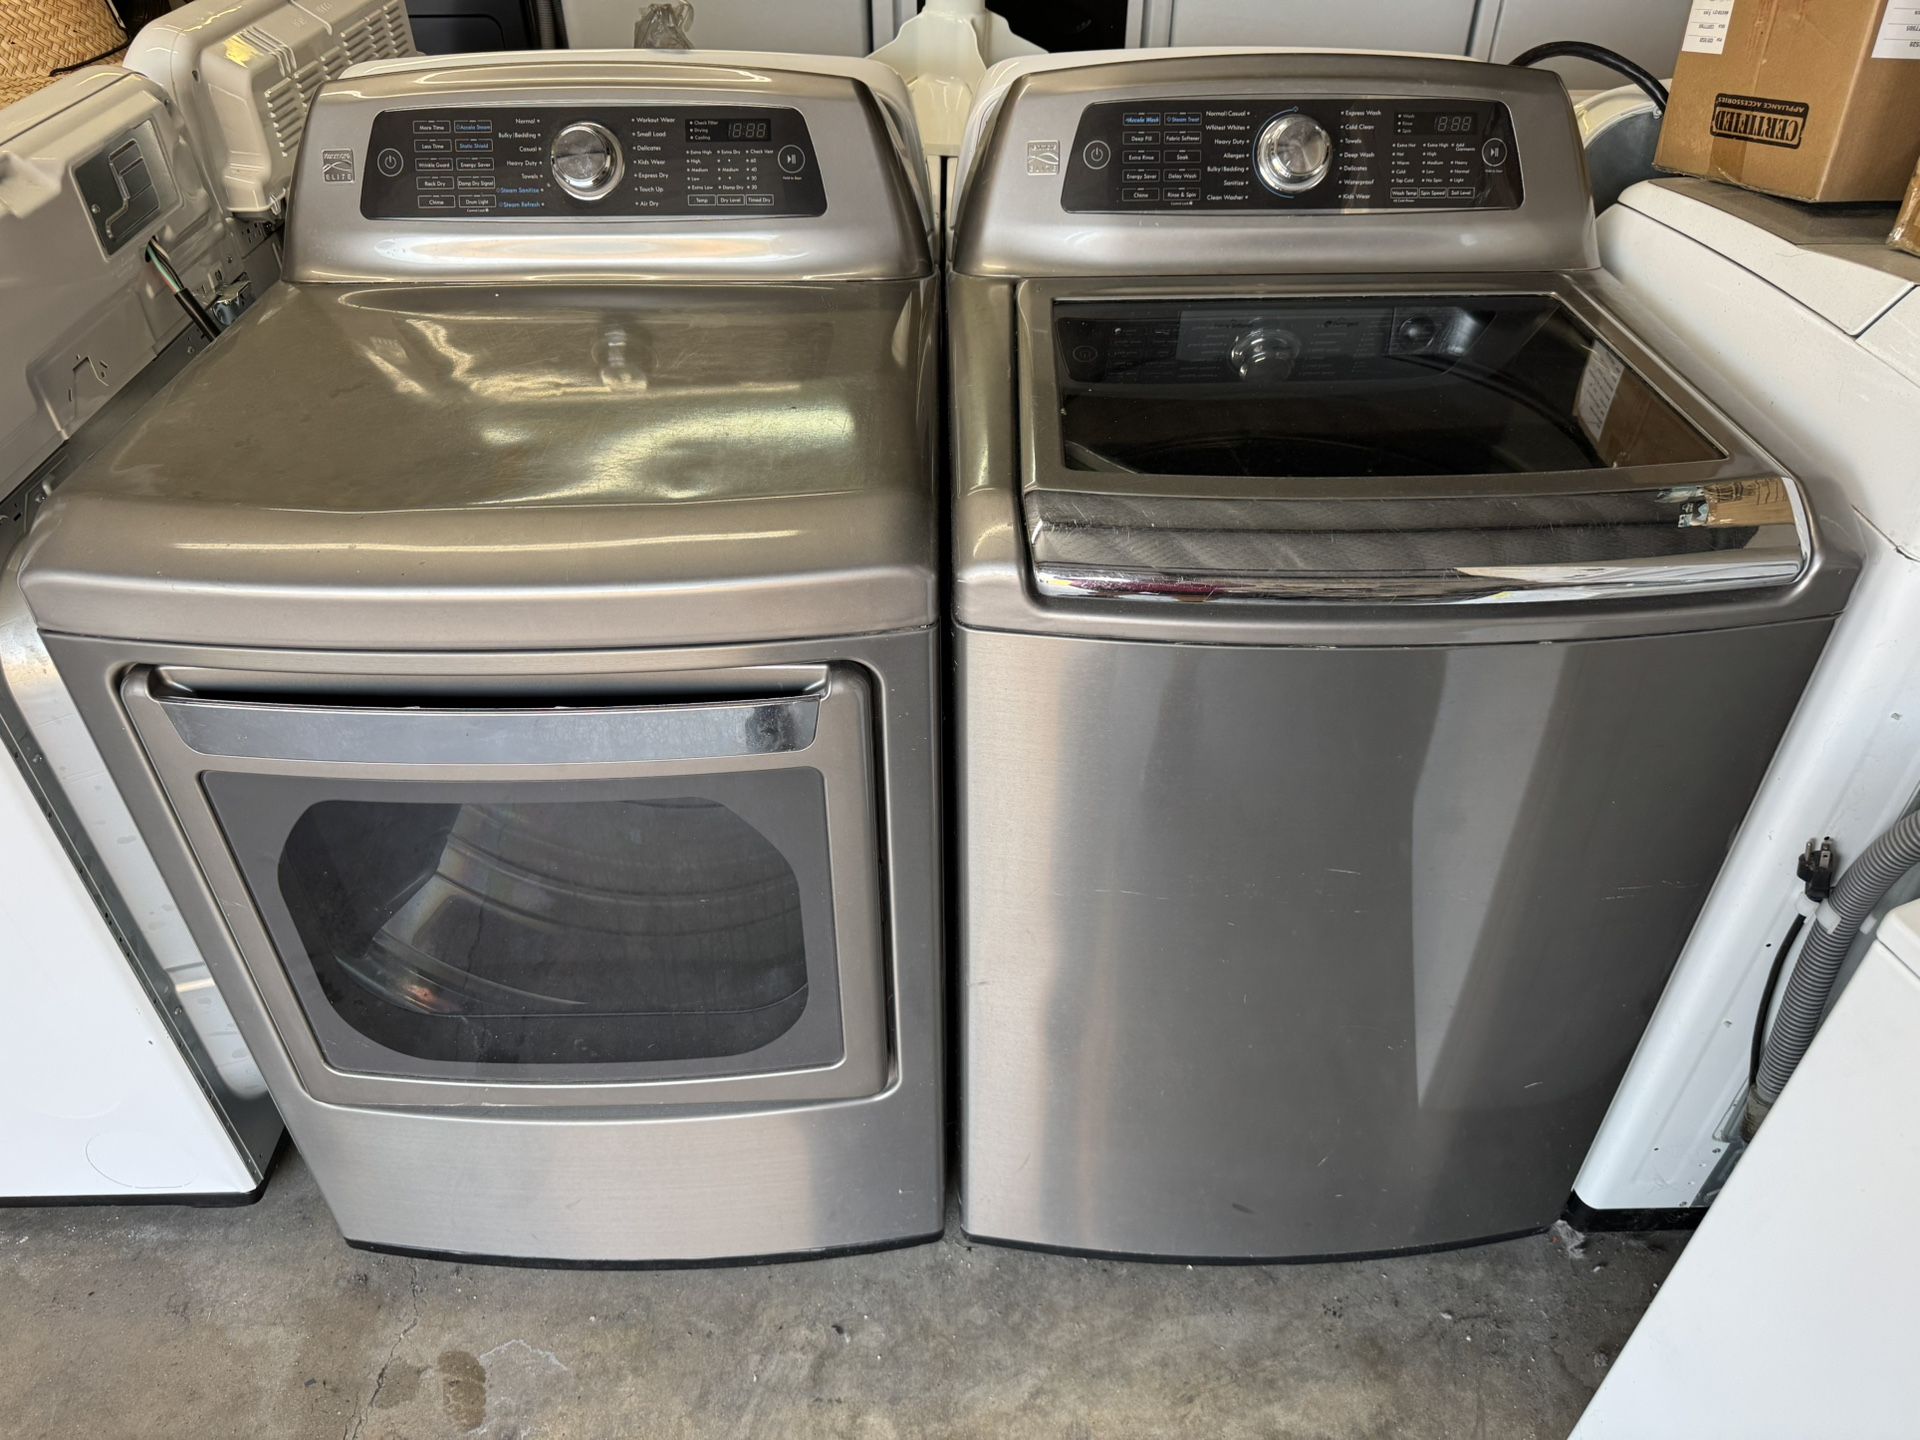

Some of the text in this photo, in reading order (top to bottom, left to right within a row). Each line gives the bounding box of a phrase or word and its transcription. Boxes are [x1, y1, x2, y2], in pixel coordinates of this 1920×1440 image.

[1718, 97, 1804, 112] APPLIANCE ACCESSORIES
[1714, 110, 1798, 142] CERTIFIED
